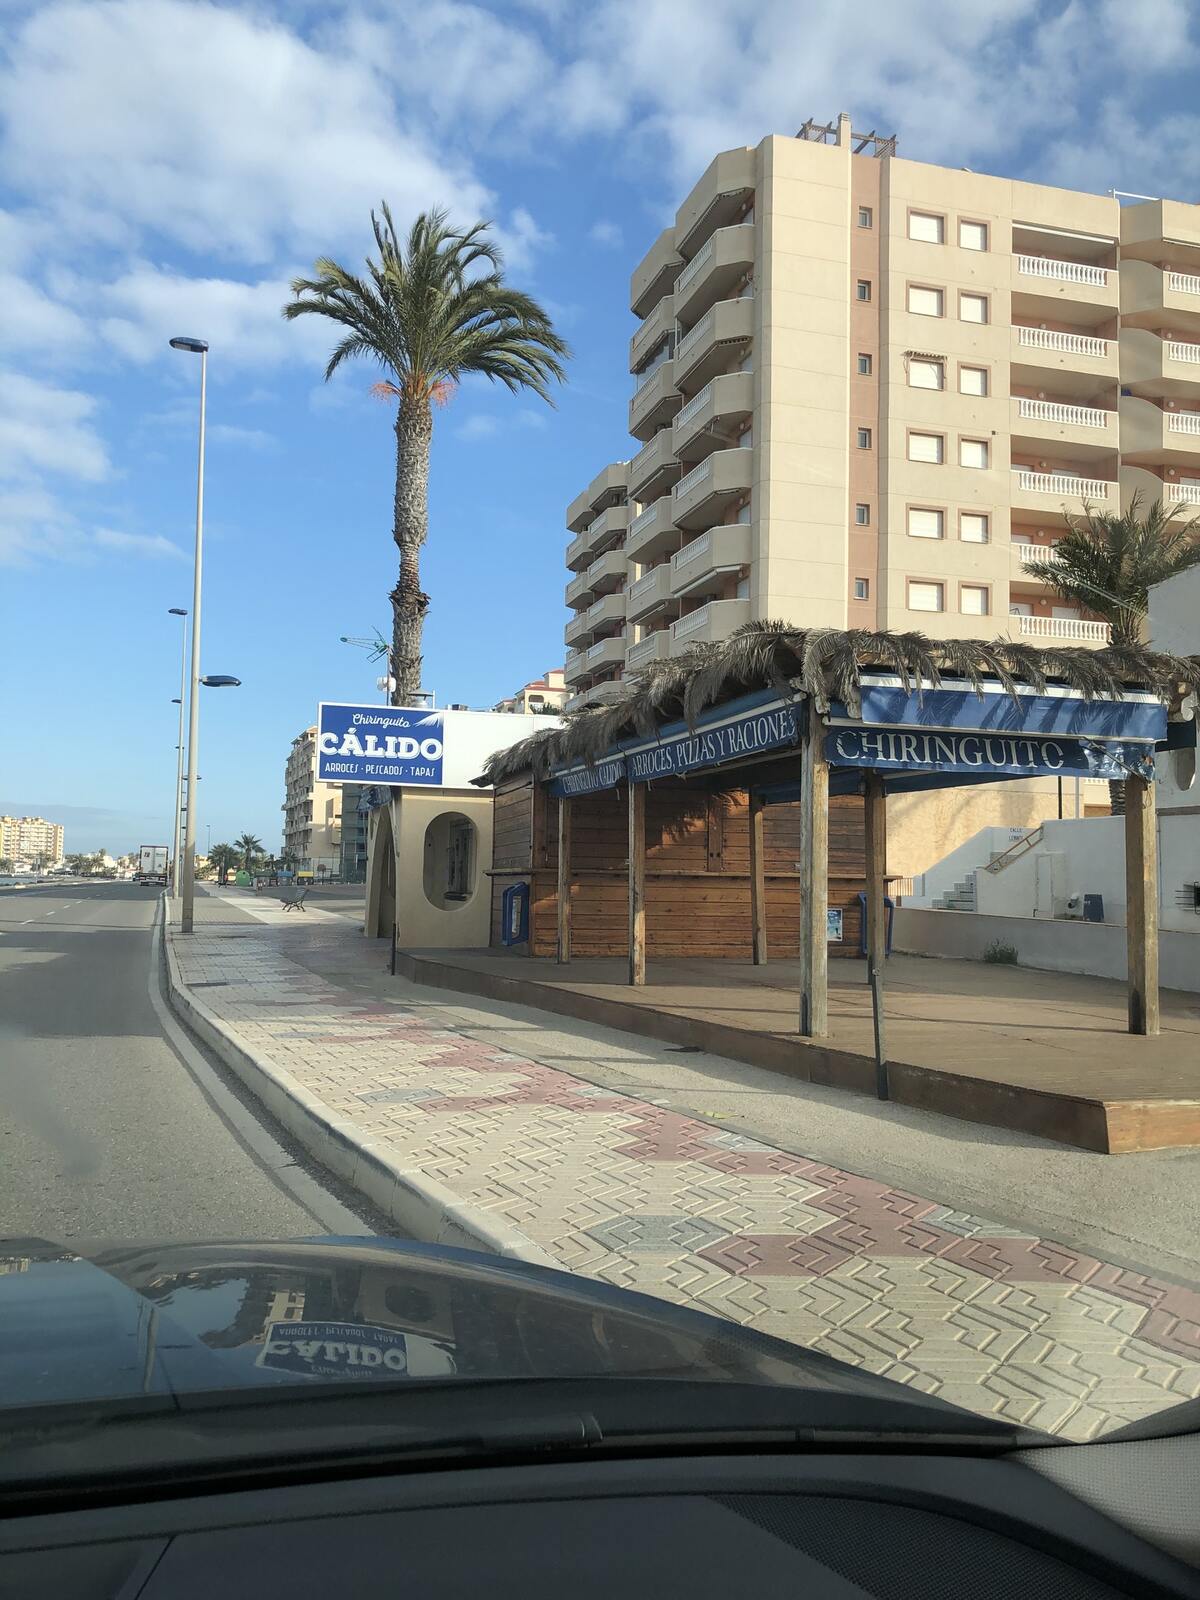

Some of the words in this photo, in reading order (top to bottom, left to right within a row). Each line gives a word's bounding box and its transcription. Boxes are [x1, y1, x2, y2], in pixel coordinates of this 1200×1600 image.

[352, 713, 411, 729] Chiringuito
[320, 727, 443, 761] CÁLIDO
[632, 747, 676, 776] ARROCES,
[677, 734, 716, 767] PIZZAS
[715, 730, 726, 756] Y
[727, 707, 796, 753] RACIONES
[836, 731, 1064, 769] CHIRINGUITO
[325, 762, 359, 774] ARROCES
[365, 764, 404, 776] PESCADOS
[410, 766, 436, 777] TAPAS
